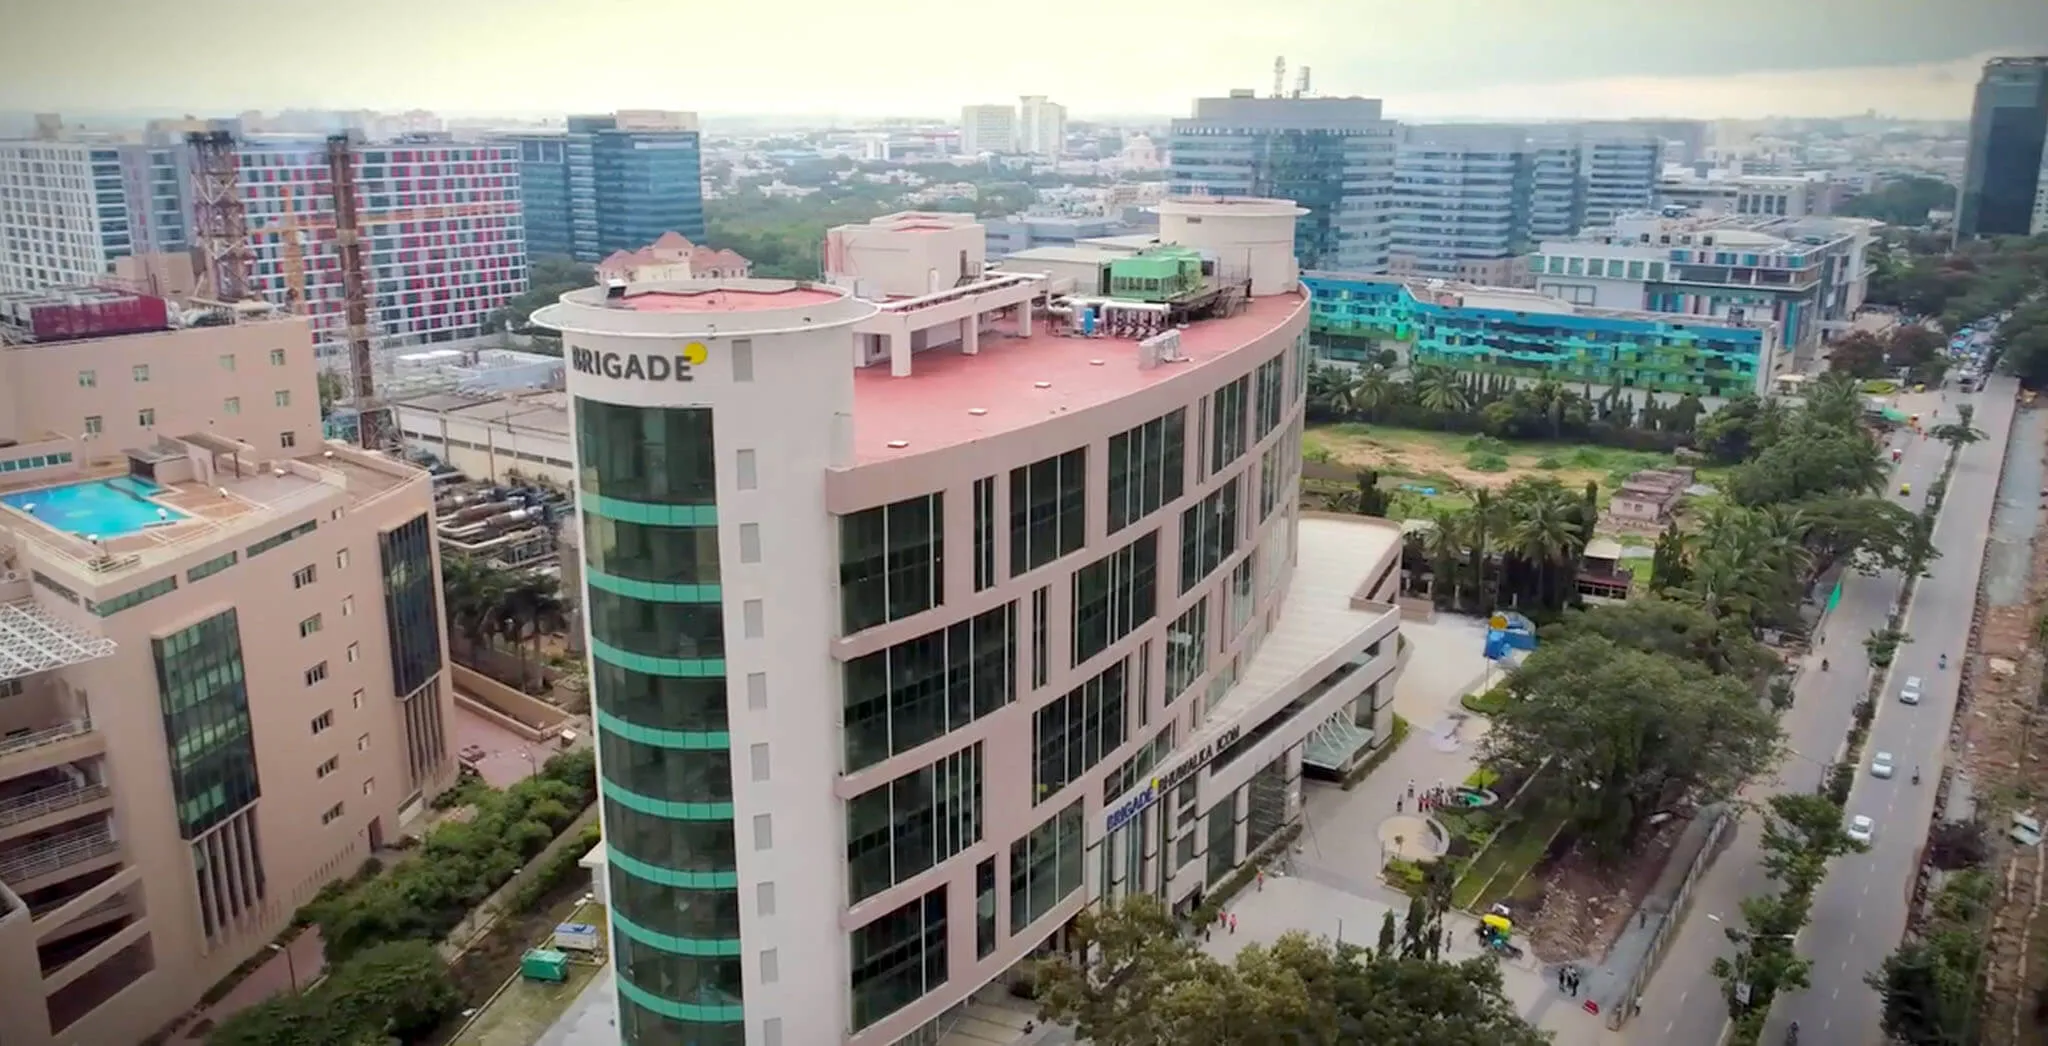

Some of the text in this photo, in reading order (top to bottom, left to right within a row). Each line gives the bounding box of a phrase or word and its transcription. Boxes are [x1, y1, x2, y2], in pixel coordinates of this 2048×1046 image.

[572, 345, 693, 381] BRIGADE
[1107, 787, 1153, 831] BRIGADE
[1216, 724, 1240, 752] ICON
